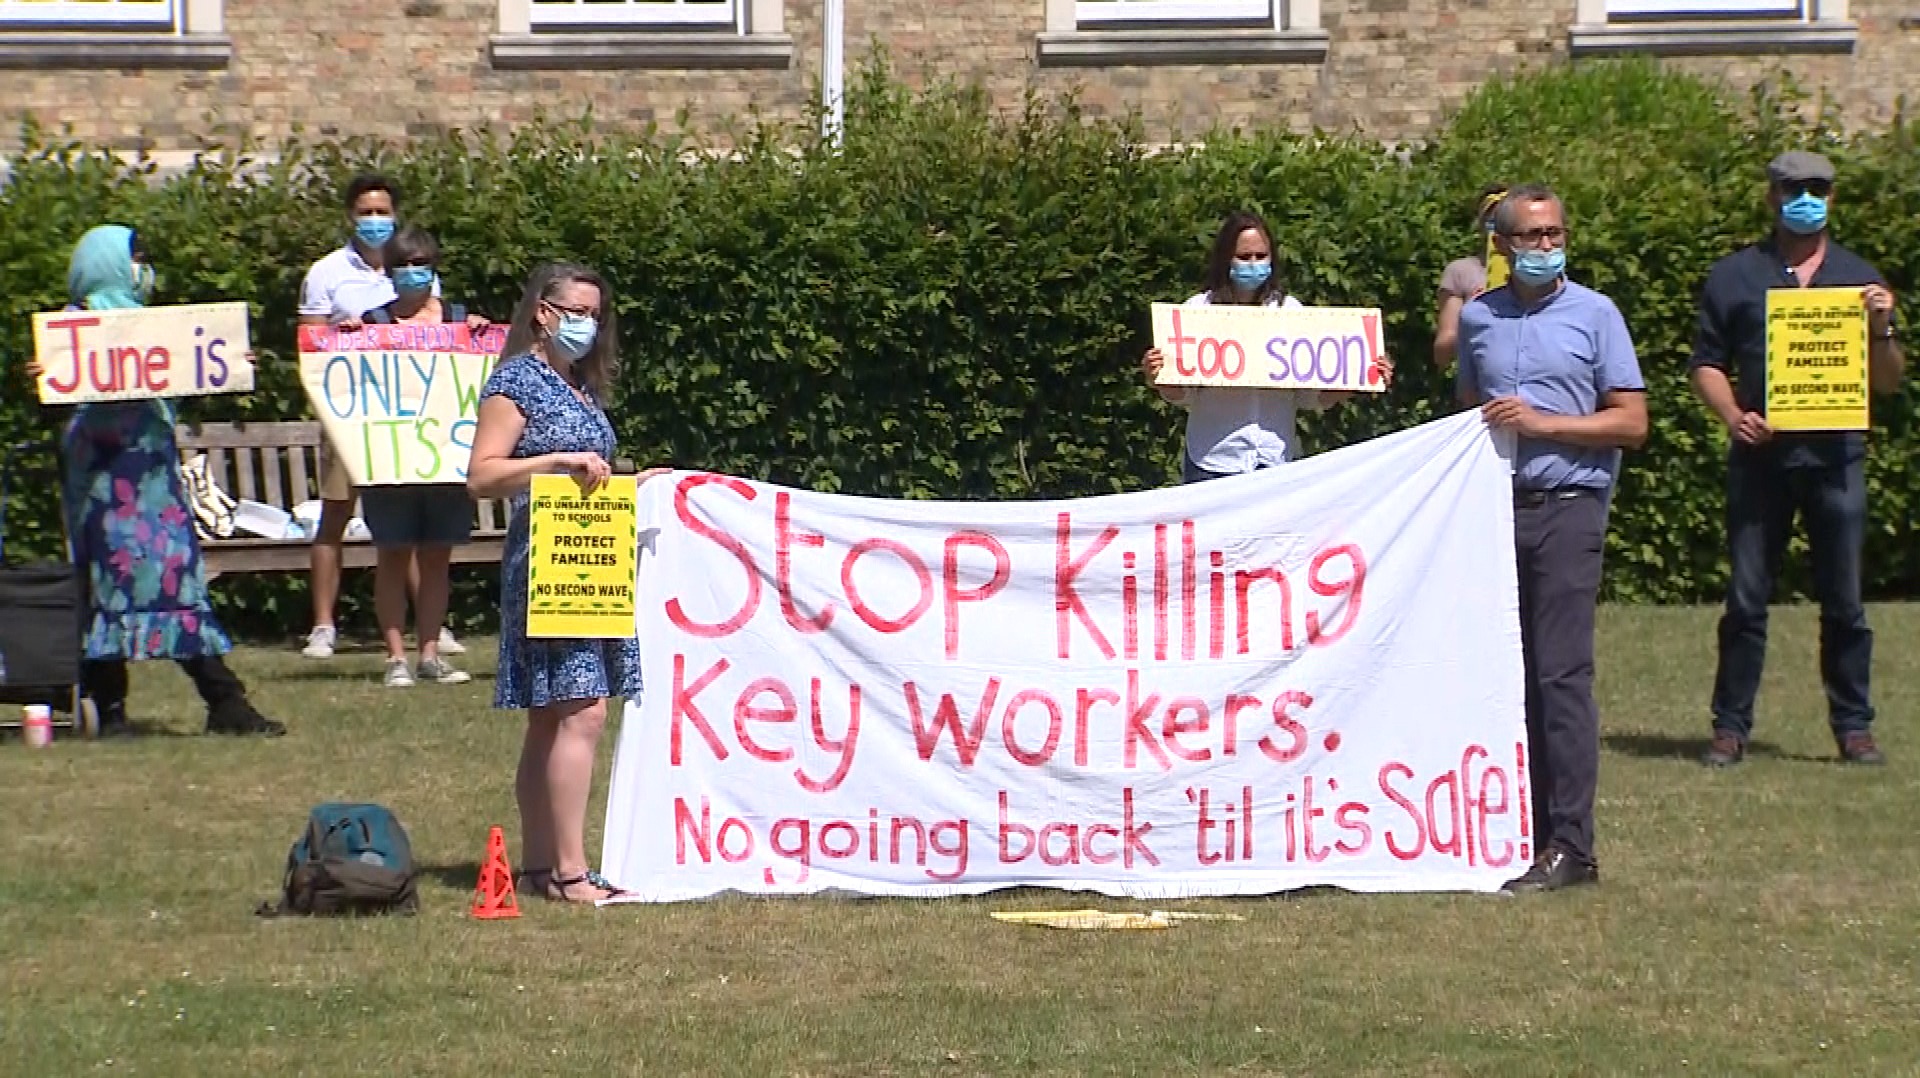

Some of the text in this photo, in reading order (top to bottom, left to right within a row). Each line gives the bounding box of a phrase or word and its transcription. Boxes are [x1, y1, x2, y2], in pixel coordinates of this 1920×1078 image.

[389, 326, 465, 350] SCHOOL
[1167, 308, 1380, 386] too soon!
[1789, 341, 1848, 352] PROTECT
[46, 317, 229, 395] June is
[1786, 356, 1849, 368] FAMILIES
[322, 353, 438, 419] ONLY
[1773, 384, 1788, 394] NO
[1790, 383, 1829, 394] SECOND
[537, 501, 630, 511] NO UNSAFE RETURN
[552, 513, 611, 523] TO SCHOOLS
[554, 535, 616, 548] PROTECT
[551, 553, 617, 566] FAMILIES
[536, 583, 628, 597] NO SECOND WAVE
[669, 653, 862, 794] Key
[673, 796, 754, 865] No
[763, 807, 969, 885] going
[998, 786, 1160, 869] back
[1285, 775, 1372, 863] it's
